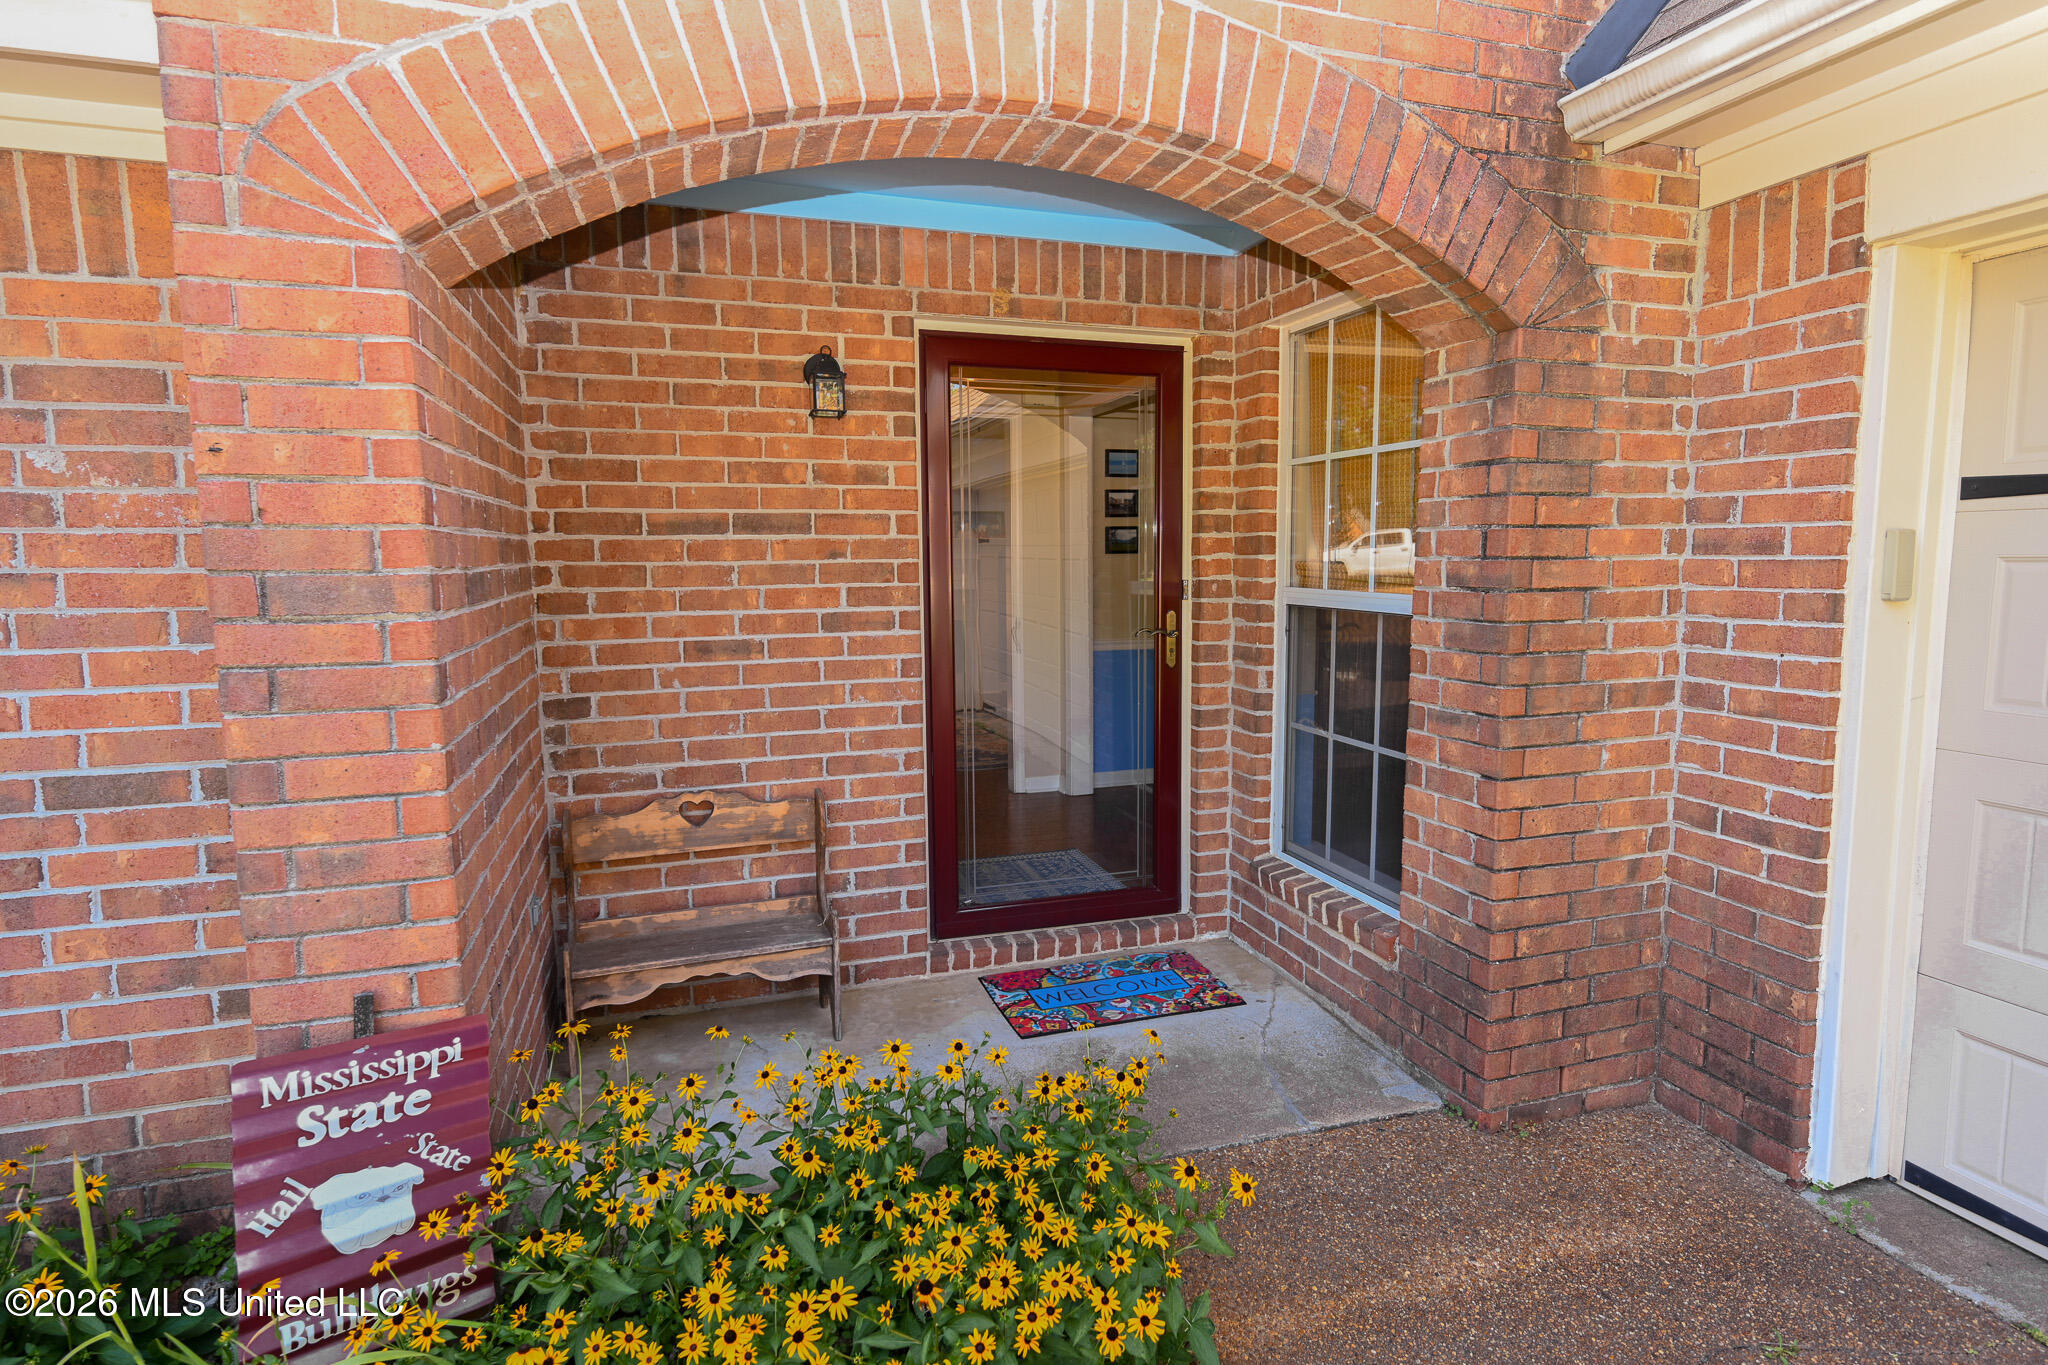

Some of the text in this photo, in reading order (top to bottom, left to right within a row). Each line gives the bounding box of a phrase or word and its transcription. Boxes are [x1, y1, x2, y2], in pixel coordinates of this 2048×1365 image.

[1035, 973, 1179, 1005] WELCOME
[260, 1037, 463, 1109] Mississippi
[297, 1088, 432, 1147] State
[247, 1132, 471, 1238] Hail State
